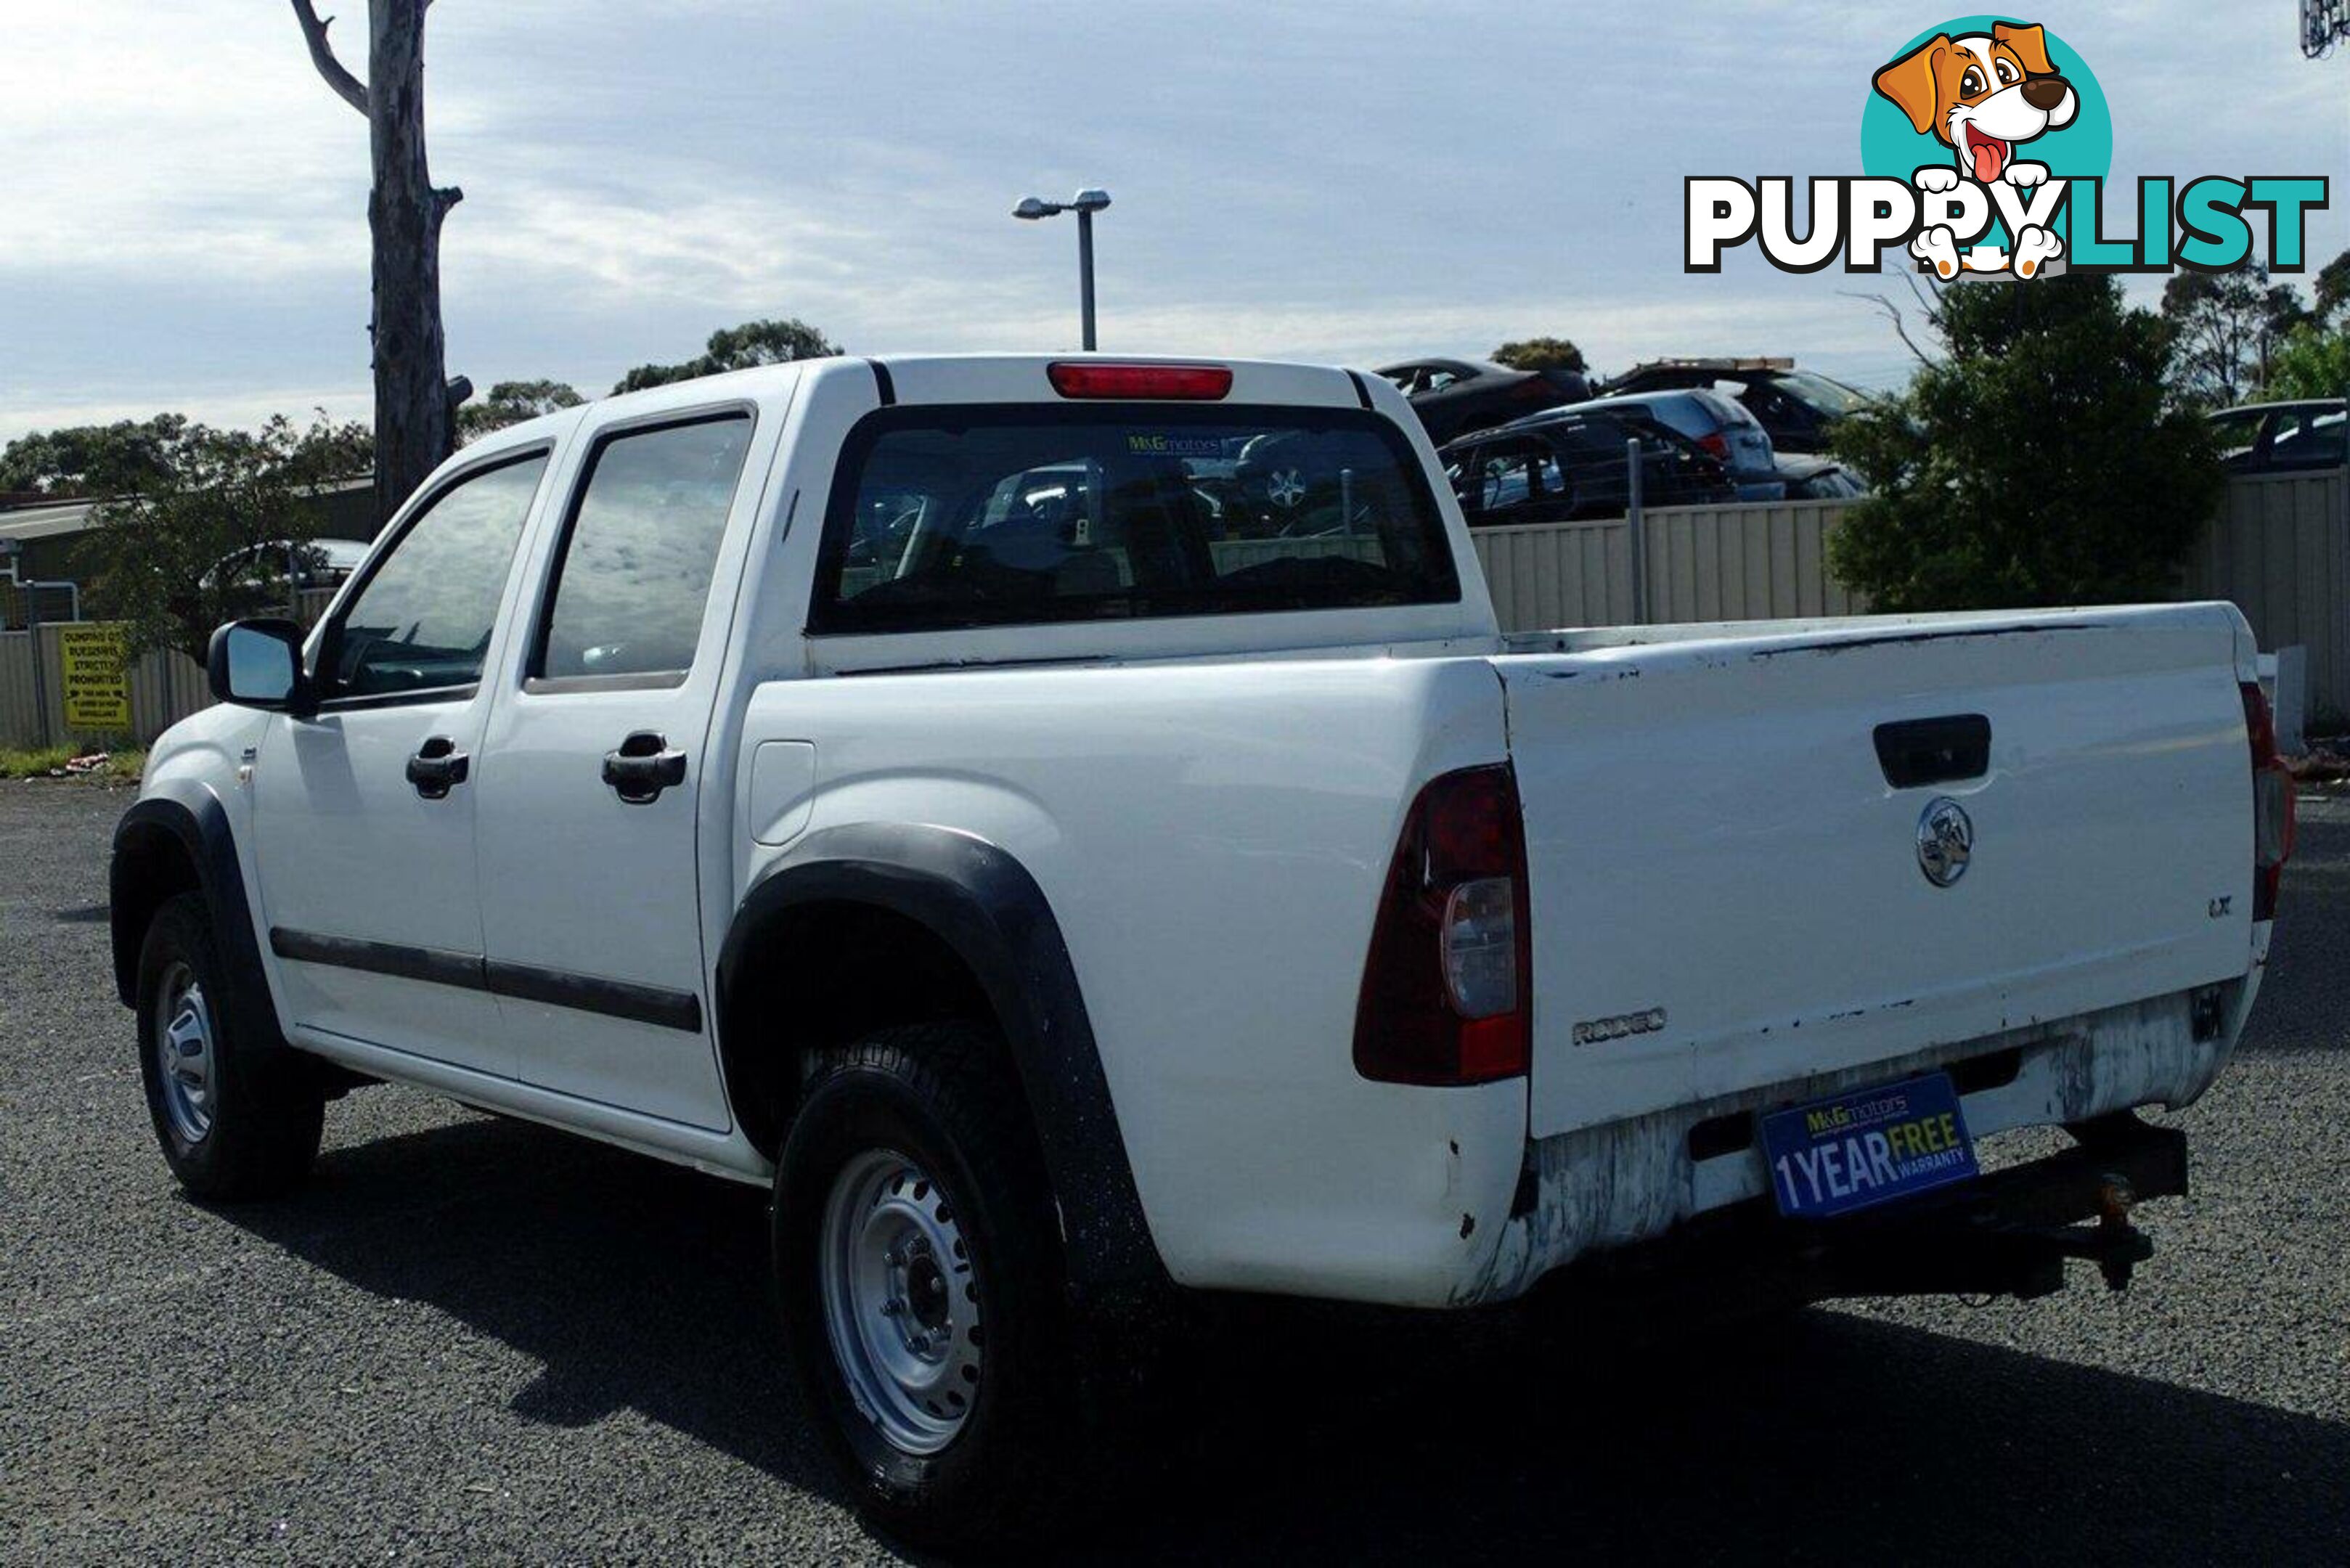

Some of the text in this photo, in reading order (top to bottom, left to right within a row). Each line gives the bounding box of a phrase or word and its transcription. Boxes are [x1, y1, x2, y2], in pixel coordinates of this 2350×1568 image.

[1572, 1005, 1668, 1046] RODEO
[1776, 1155, 1800, 1209] 1
[1887, 1113, 1959, 1161] FREE
[1897, 1147, 1964, 1179] WARRANTY
